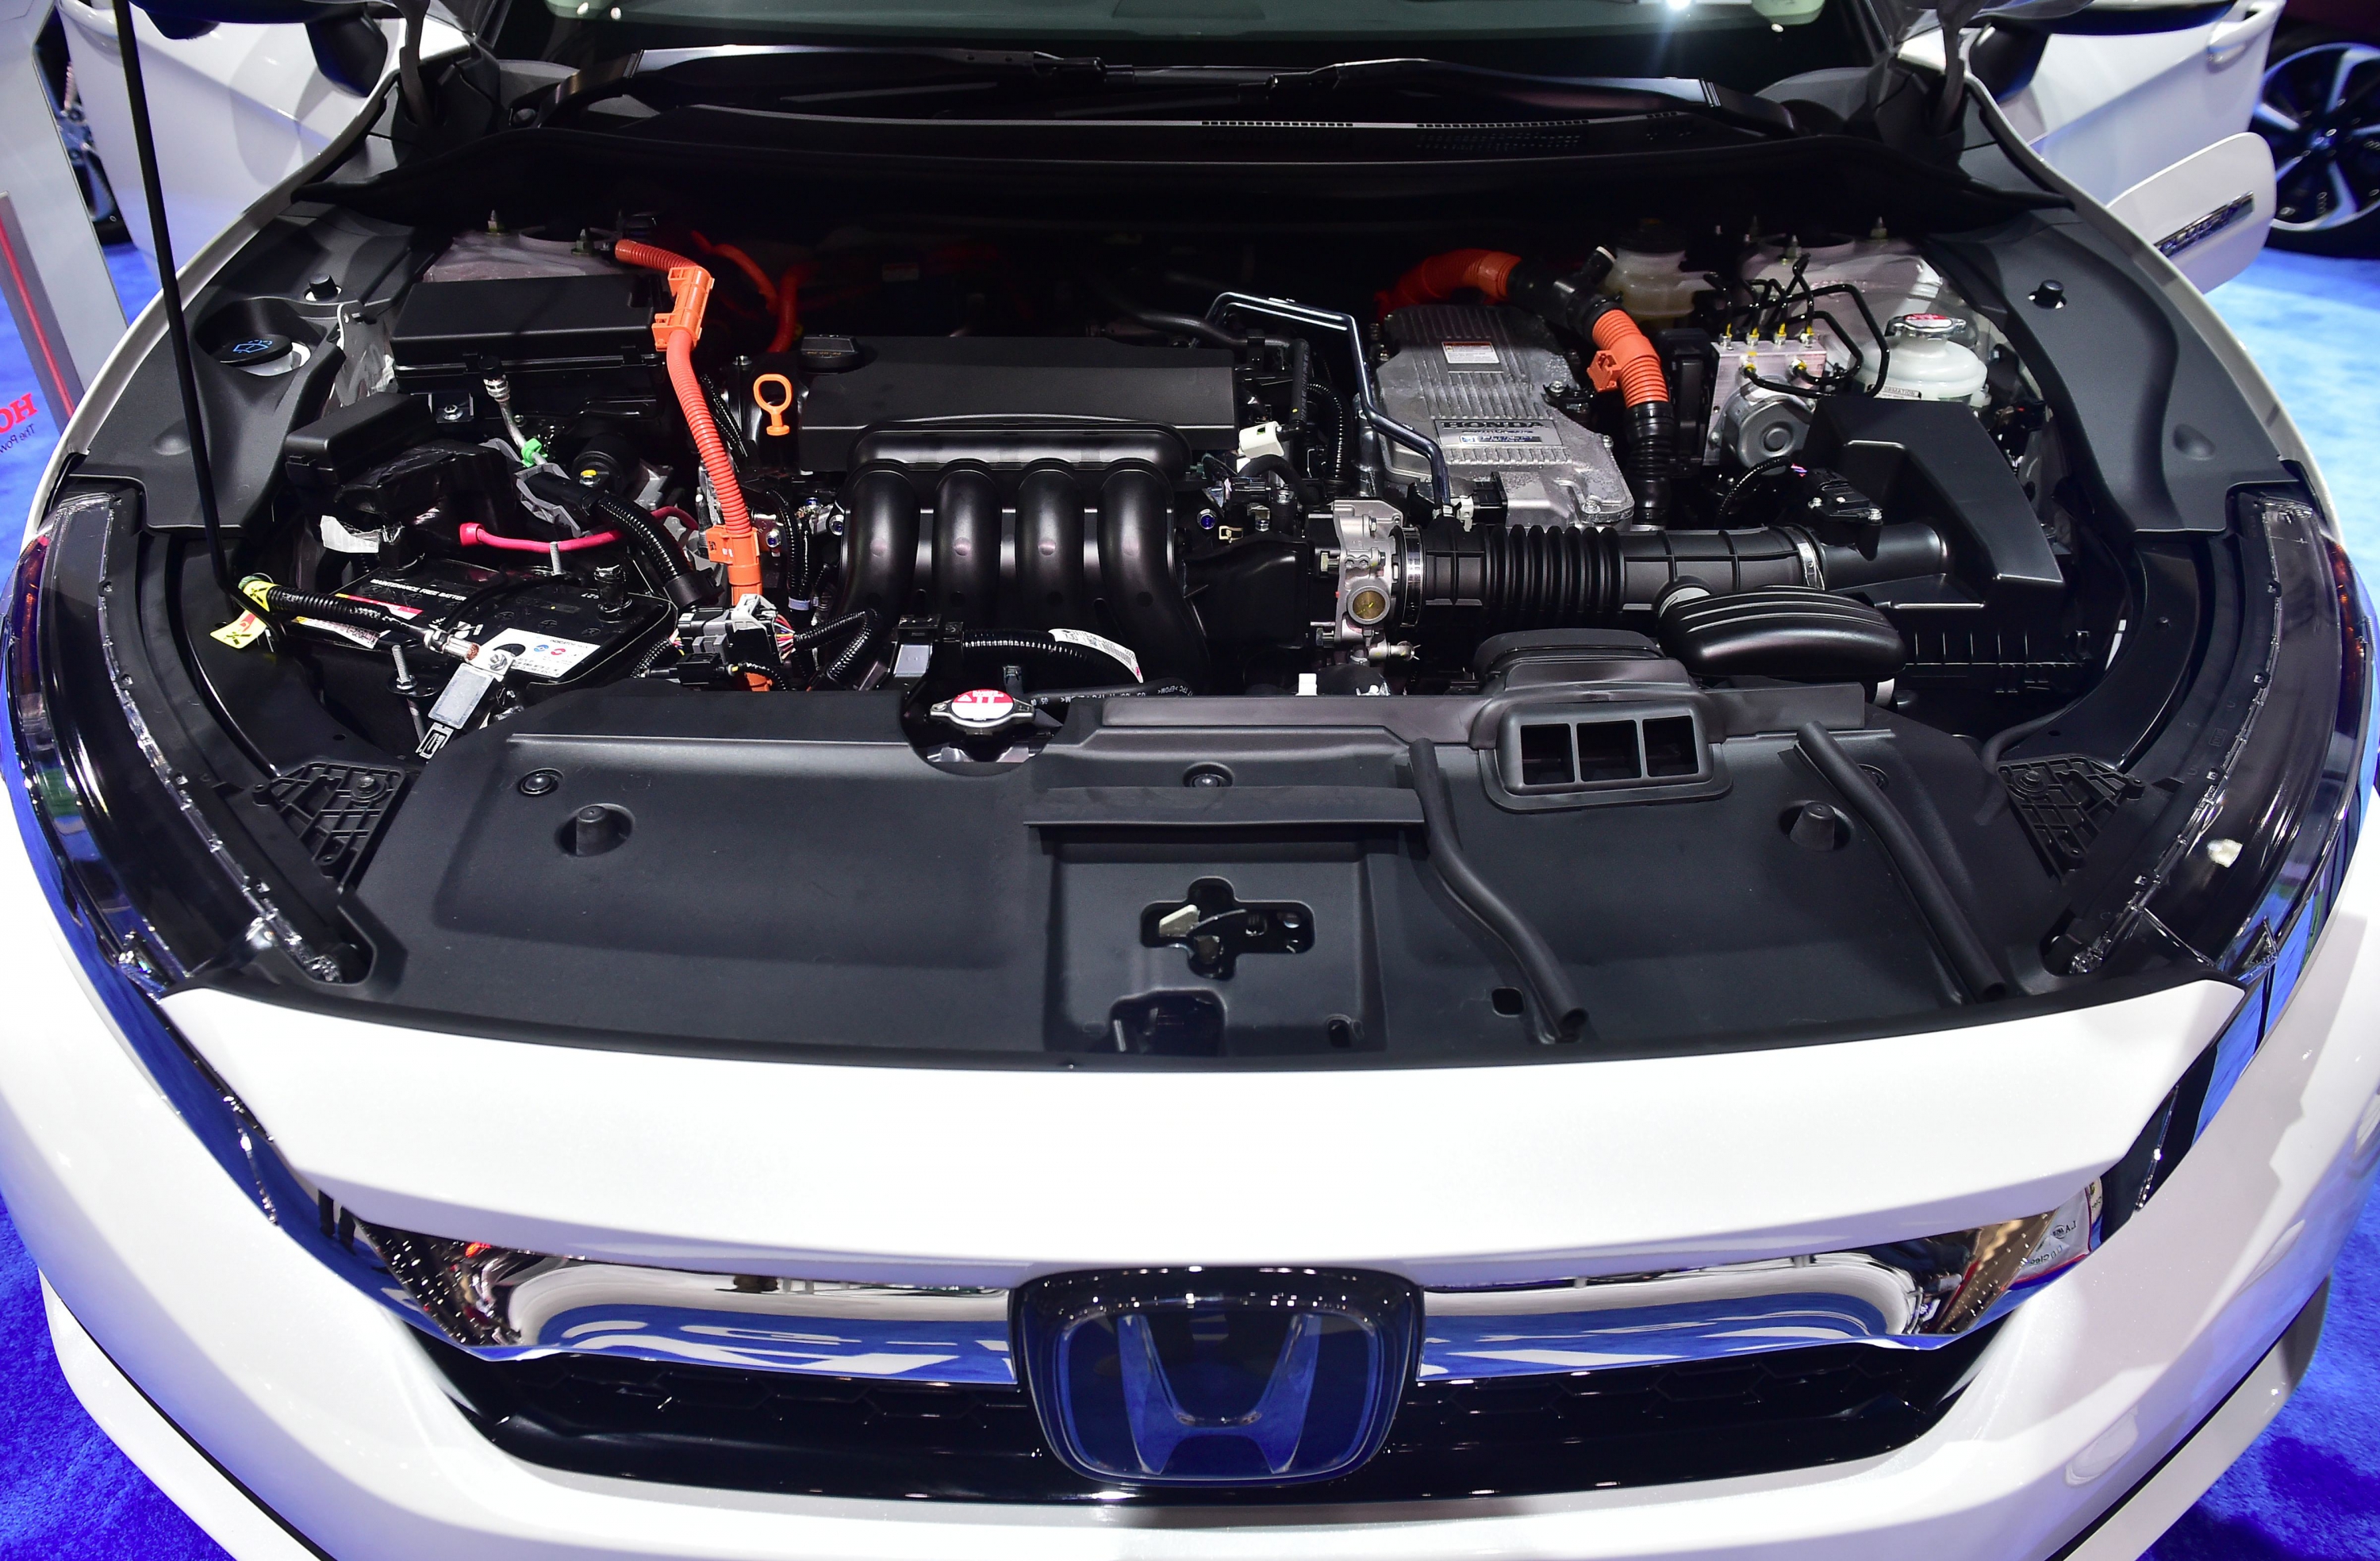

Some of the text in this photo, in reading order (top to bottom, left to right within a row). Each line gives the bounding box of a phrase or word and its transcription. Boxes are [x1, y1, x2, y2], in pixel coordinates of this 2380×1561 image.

[1883, 385, 1915, 396] ORMATION
[1441, 421, 1548, 430] HONDA
[370, 578, 467, 601] MAINTENANCE FREE BATTER
